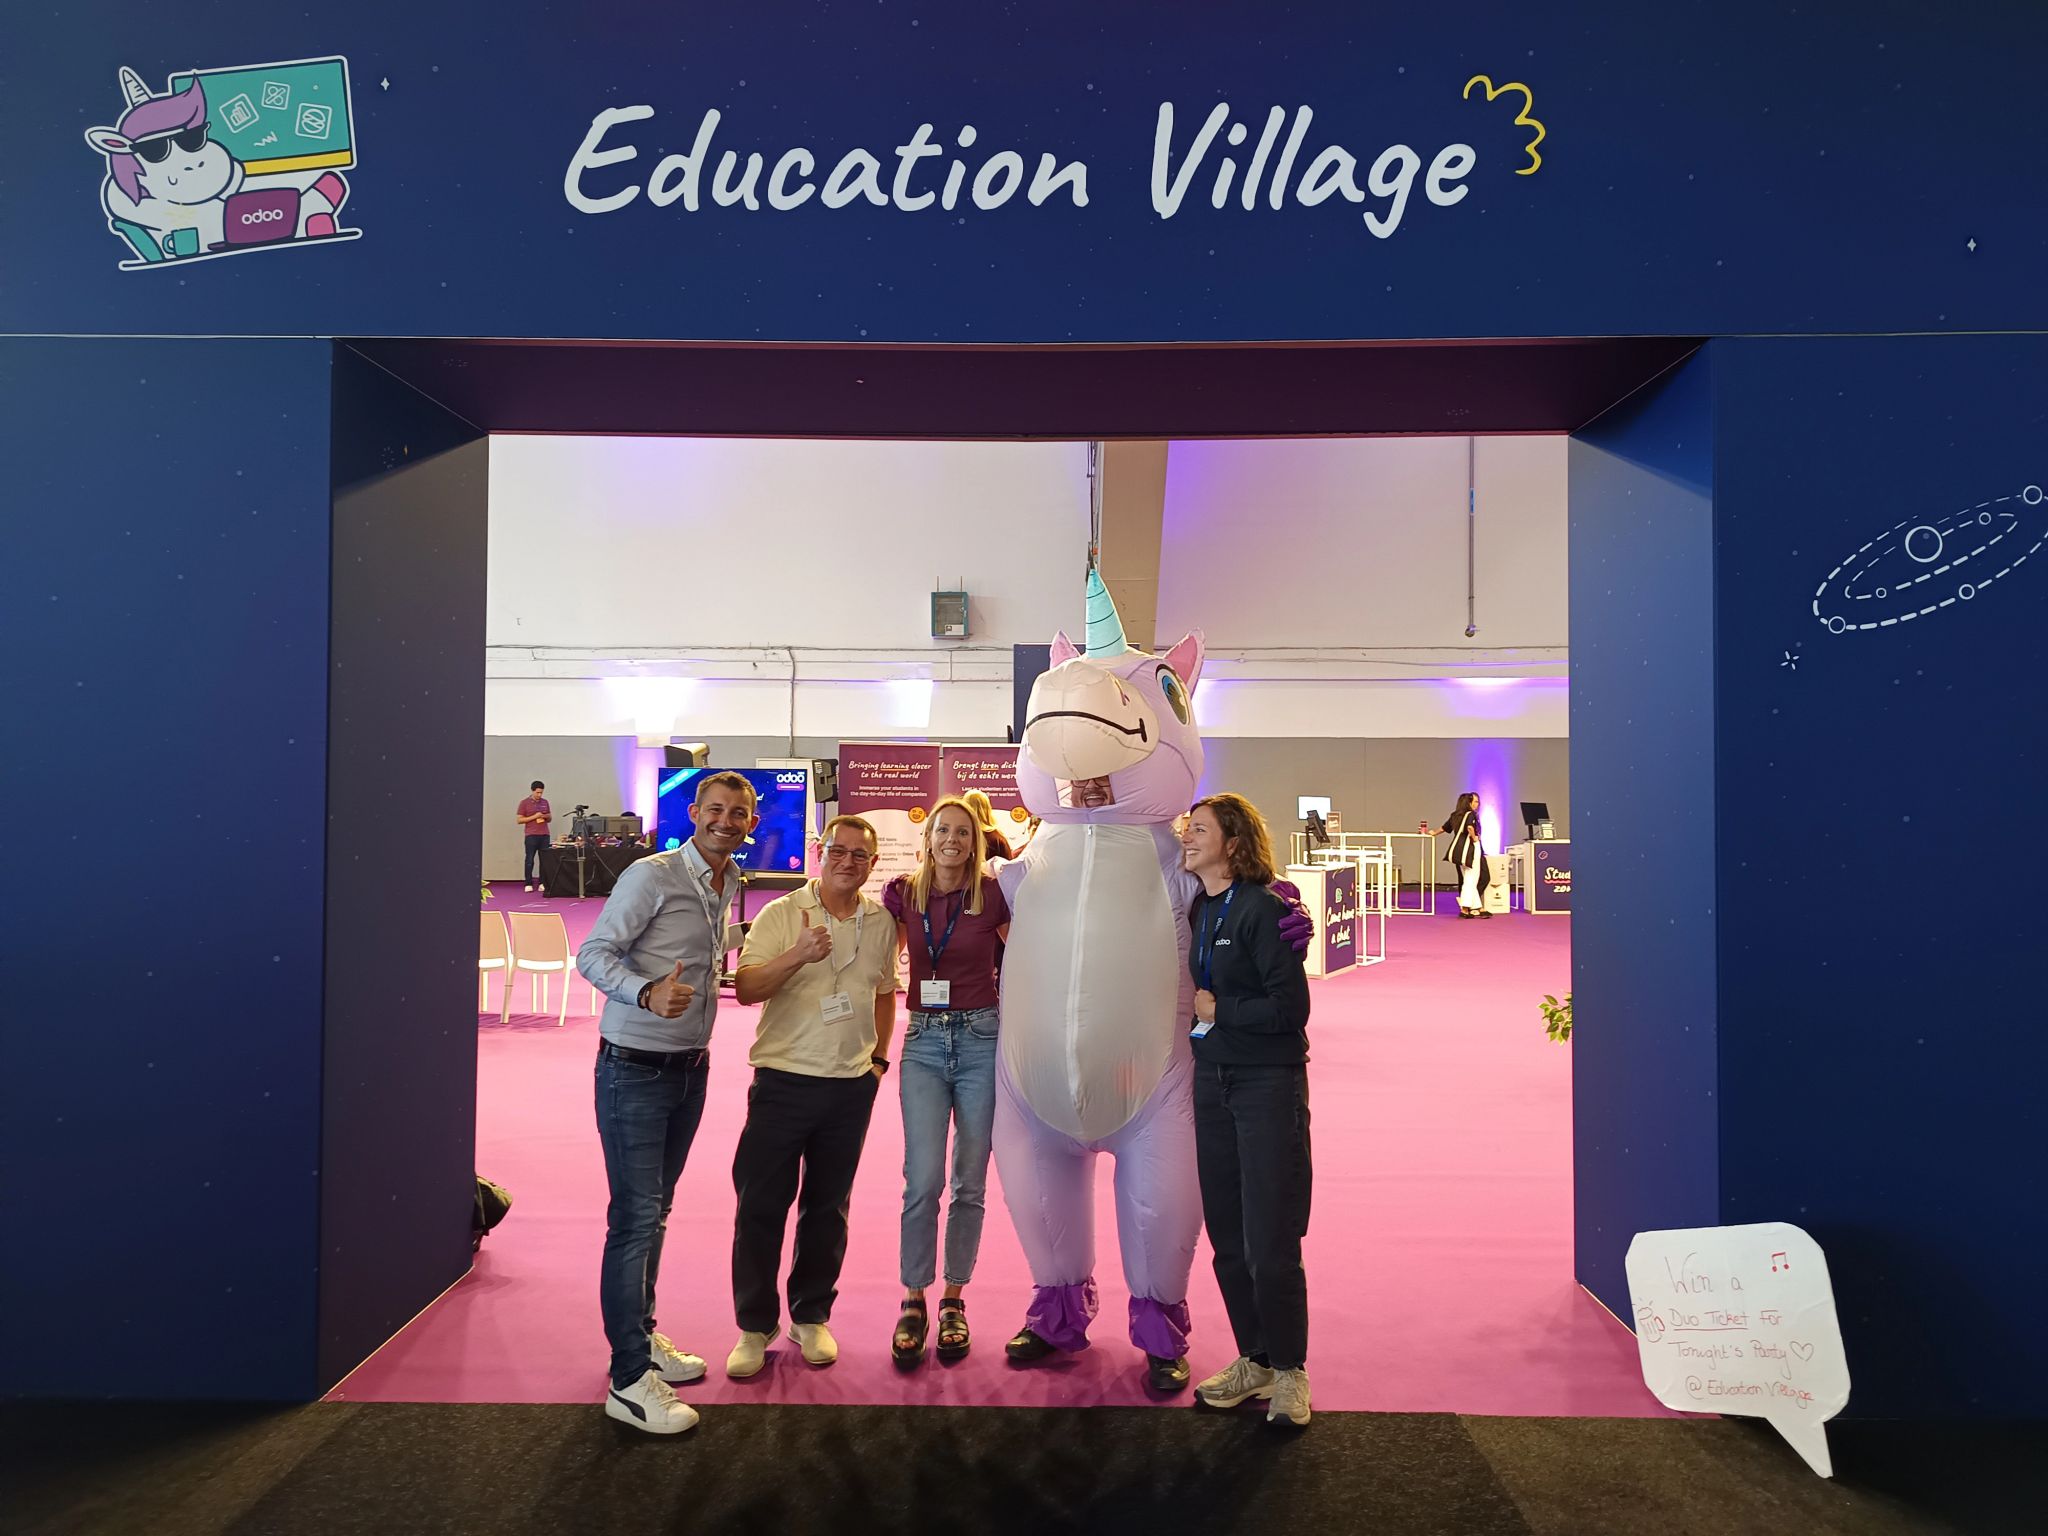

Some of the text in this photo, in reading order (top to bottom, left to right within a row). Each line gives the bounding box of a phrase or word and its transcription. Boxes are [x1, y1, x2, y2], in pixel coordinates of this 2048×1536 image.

[564, 101, 1477, 239] Education Village
[241, 208, 283, 225] odoo
[848, 760, 932, 771] Bringing learning closer
[953, 760, 1018, 770] Brengt leren dich
[776, 771, 805, 783] odoo
[900, 771, 920, 779] world
[957, 770, 968, 781] bij
[968, 771, 978, 779] de
[979, 771, 999, 779] echte
[1544, 867, 1571, 880] Stud
[1326, 906, 1341, 928] Come
[1664, 1251, 1745, 1294] Win a
[1668, 1307, 1783, 1327] Duo Ticket For
[1667, 1339, 1792, 1381] Tonight's Party
[1685, 1375, 1815, 1409] @ Education Village
